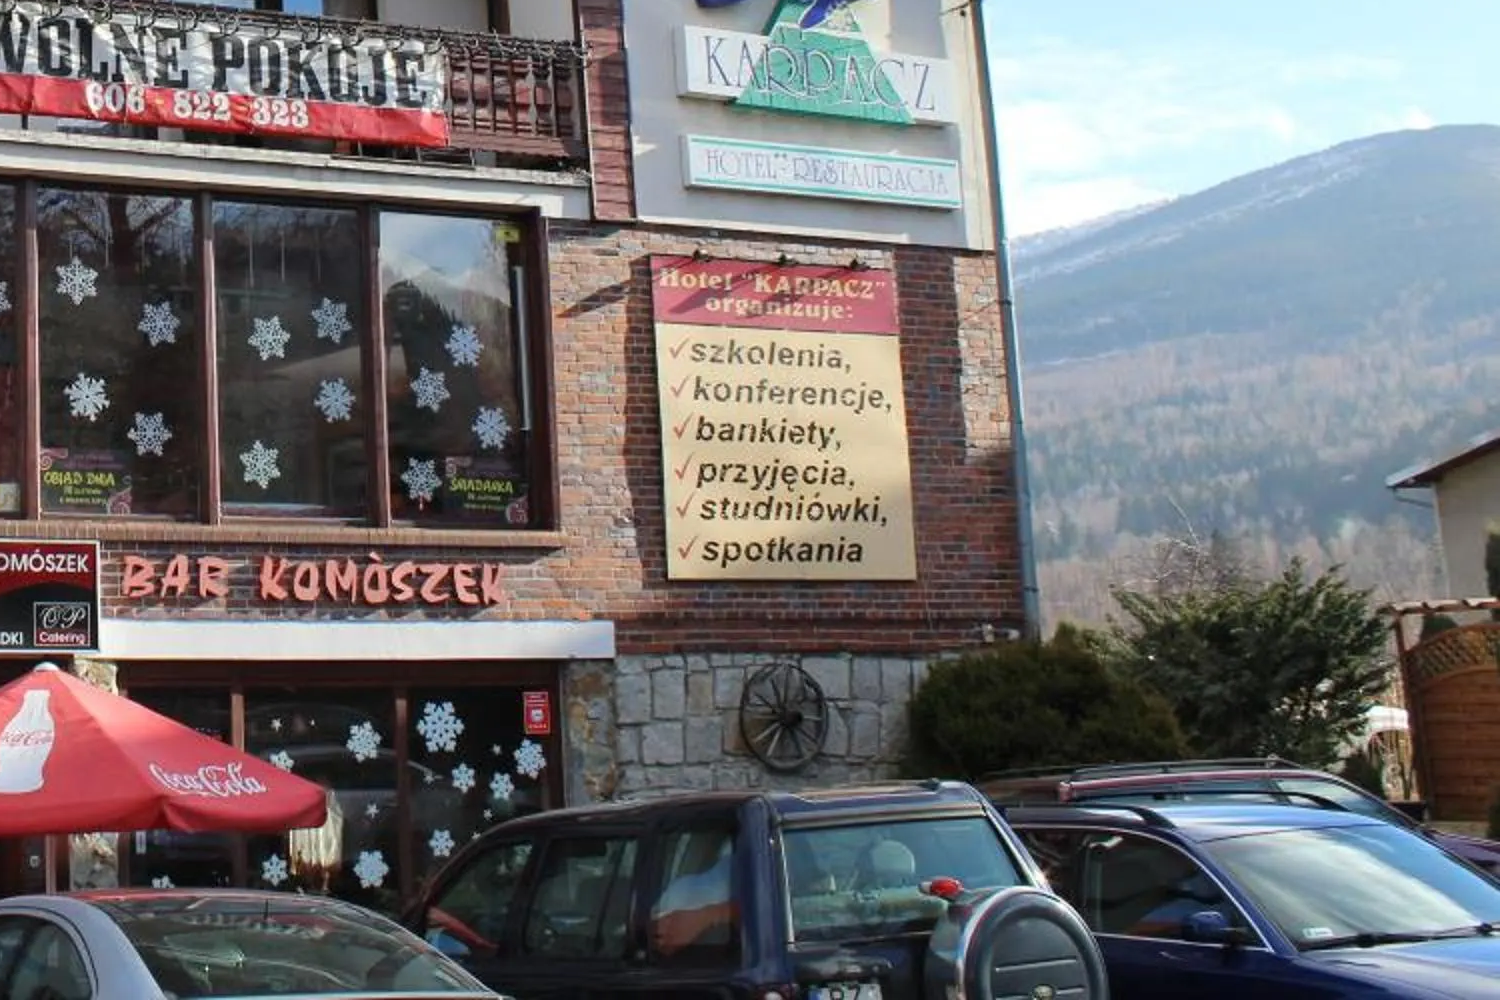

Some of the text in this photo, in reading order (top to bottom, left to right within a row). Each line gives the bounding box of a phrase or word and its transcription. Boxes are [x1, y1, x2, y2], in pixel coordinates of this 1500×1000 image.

[210, 34, 430, 108] POKOJE
[704, 35, 935, 112] KARPACZ
[85, 80, 310, 128] 606 822 323
[659, 268, 734, 292] Hotel
[690, 339, 852, 374] szkolenia,
[693, 376, 892, 414] konferencje,
[695, 416, 842, 452] bankiety,
[696, 459, 856, 492] przyjęcia,
[700, 493, 888, 527] studniówki,
[701, 537, 864, 568] spotkania
[121, 553, 230, 598] BAR
[39, 631, 86, 645] Catering
